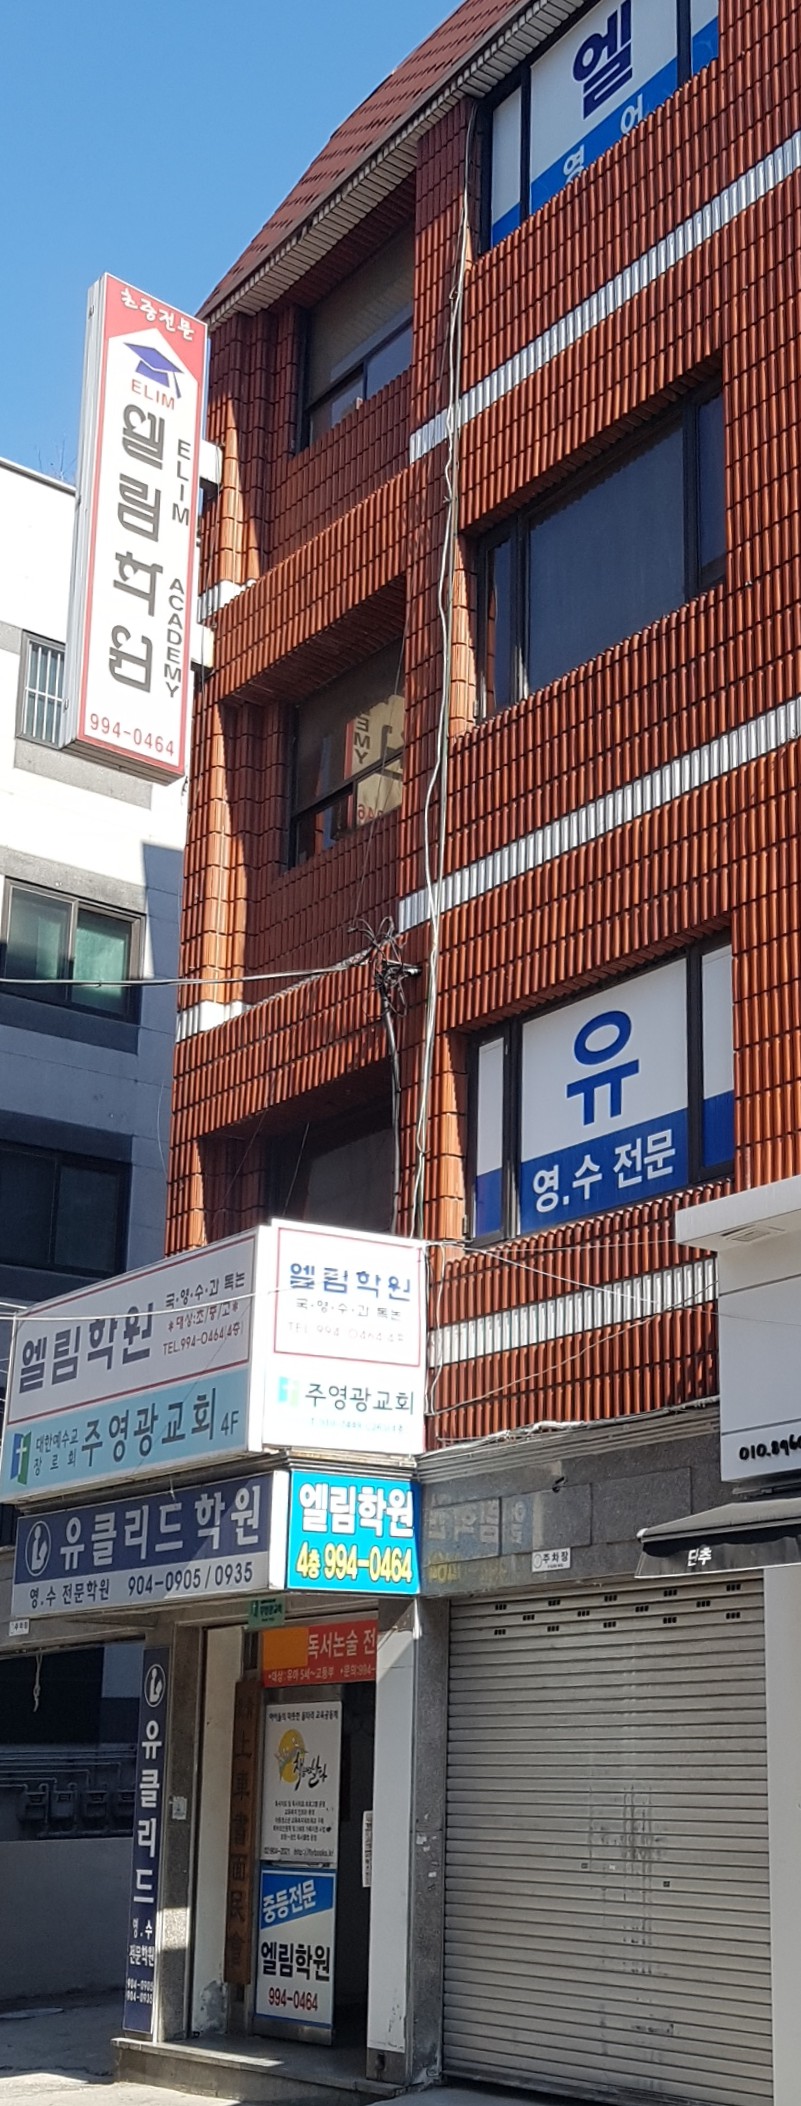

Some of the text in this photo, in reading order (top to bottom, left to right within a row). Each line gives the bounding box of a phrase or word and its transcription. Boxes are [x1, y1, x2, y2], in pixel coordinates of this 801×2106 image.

[572, 0, 632, 121] 엘
[131, 378, 175, 410] ELIM
[108, 403, 165, 692] 엘림학원
[164, 438, 192, 698] ELIM ACADEMY
[90, 713, 174, 757] 994-0464
[566, 1010, 640, 1126] 유
[533, 1129, 676, 1213] 영.수 전문
[290, 1262, 411, 1303] 엘림학원
[19, 1303, 153, 1394] 엘림학원
[305, 1382, 415, 1416] 주영광교회
[36, 1387, 240, 1467] 대한예수교 주영광교회 4F
[60, 1485, 261, 1571] 유클리드학원
[300, 1482, 415, 1538] 엘림학원
[296, 1541, 320, 1580] 4층
[324, 1543, 413, 1583] 994-0464
[543, 1551, 569, 1564] 주차장
[687, 1547, 712, 1567] 단추
[29, 1582, 56, 1610] 영.수
[62, 1578, 110, 1605] 전문학원
[308, 1629, 358, 1660] 독서논술
[133, 1719, 162, 1904] 유클리드
[263, 1879, 316, 1924] 중등전문
[261, 1941, 331, 1982] 엘림학원
[268, 1987, 318, 2011] 994-0464
